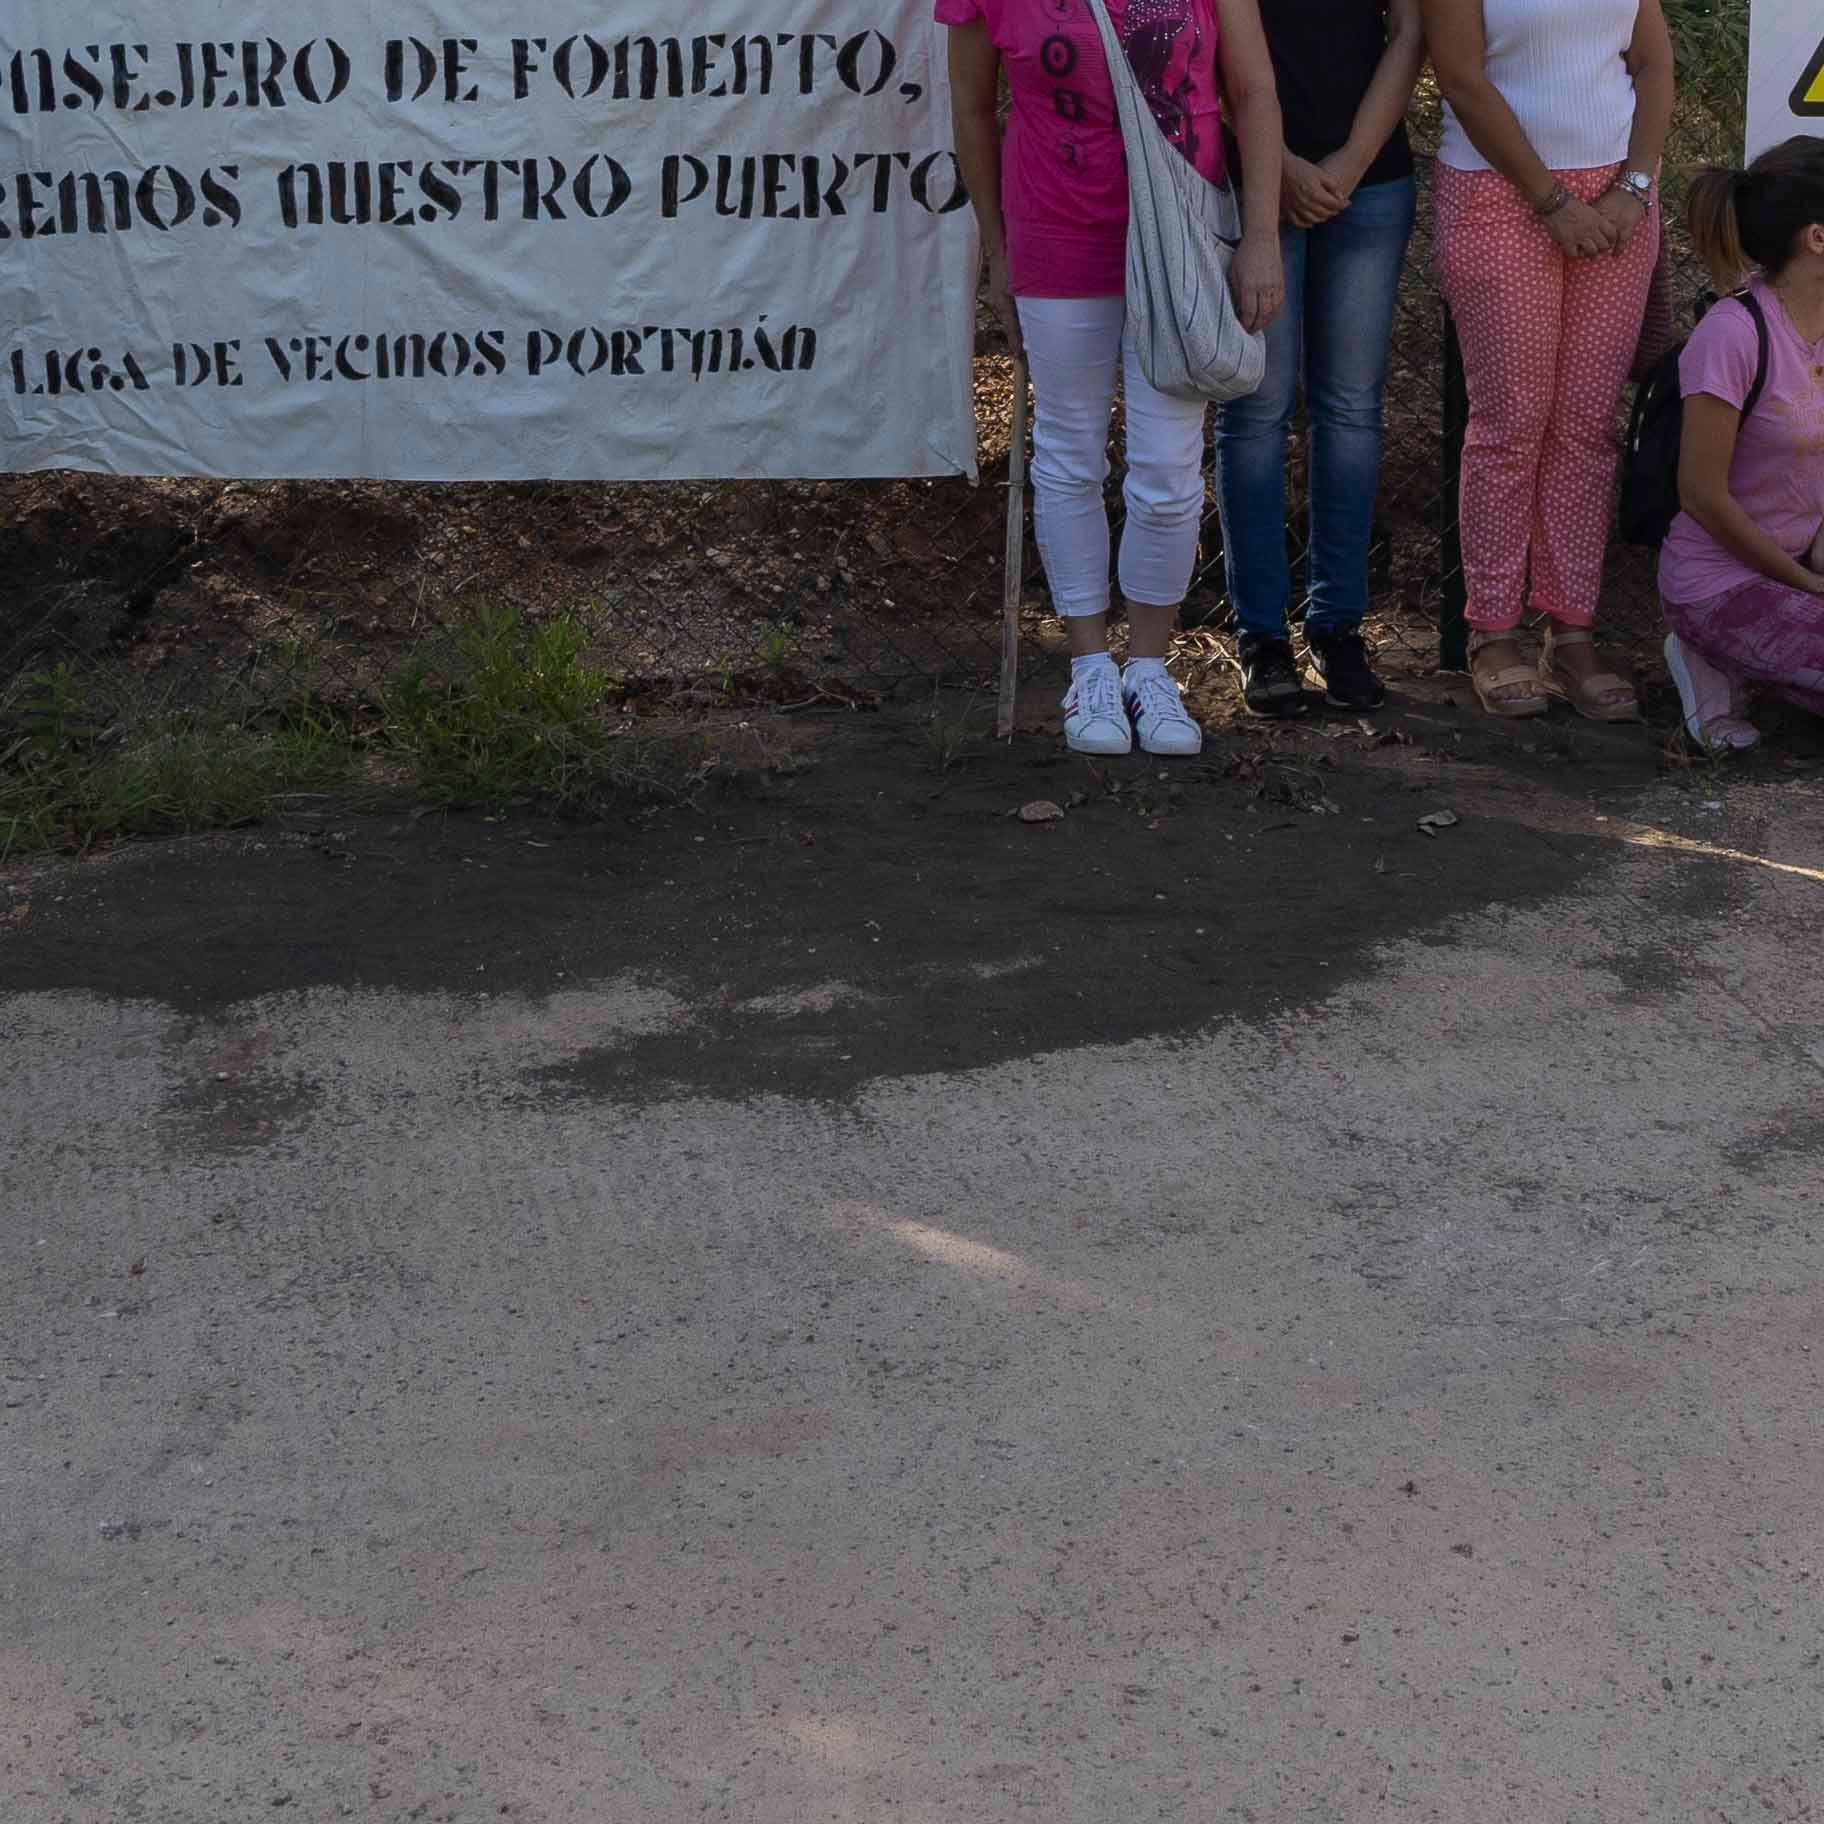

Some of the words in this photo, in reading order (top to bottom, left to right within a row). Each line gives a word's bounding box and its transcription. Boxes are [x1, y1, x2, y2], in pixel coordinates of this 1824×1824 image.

[385, 37, 478, 102] DE
[512, 30, 922, 104] FOMENTO,
[278, 154, 631, 228] NUESTRO
[662, 149, 971, 219] PUERTO
[11, 348, 149, 394] LIGA
[173, 340, 242, 386] DE
[265, 331, 505, 381] VECINOS
[527, 315, 816, 381] PORTMÁN
